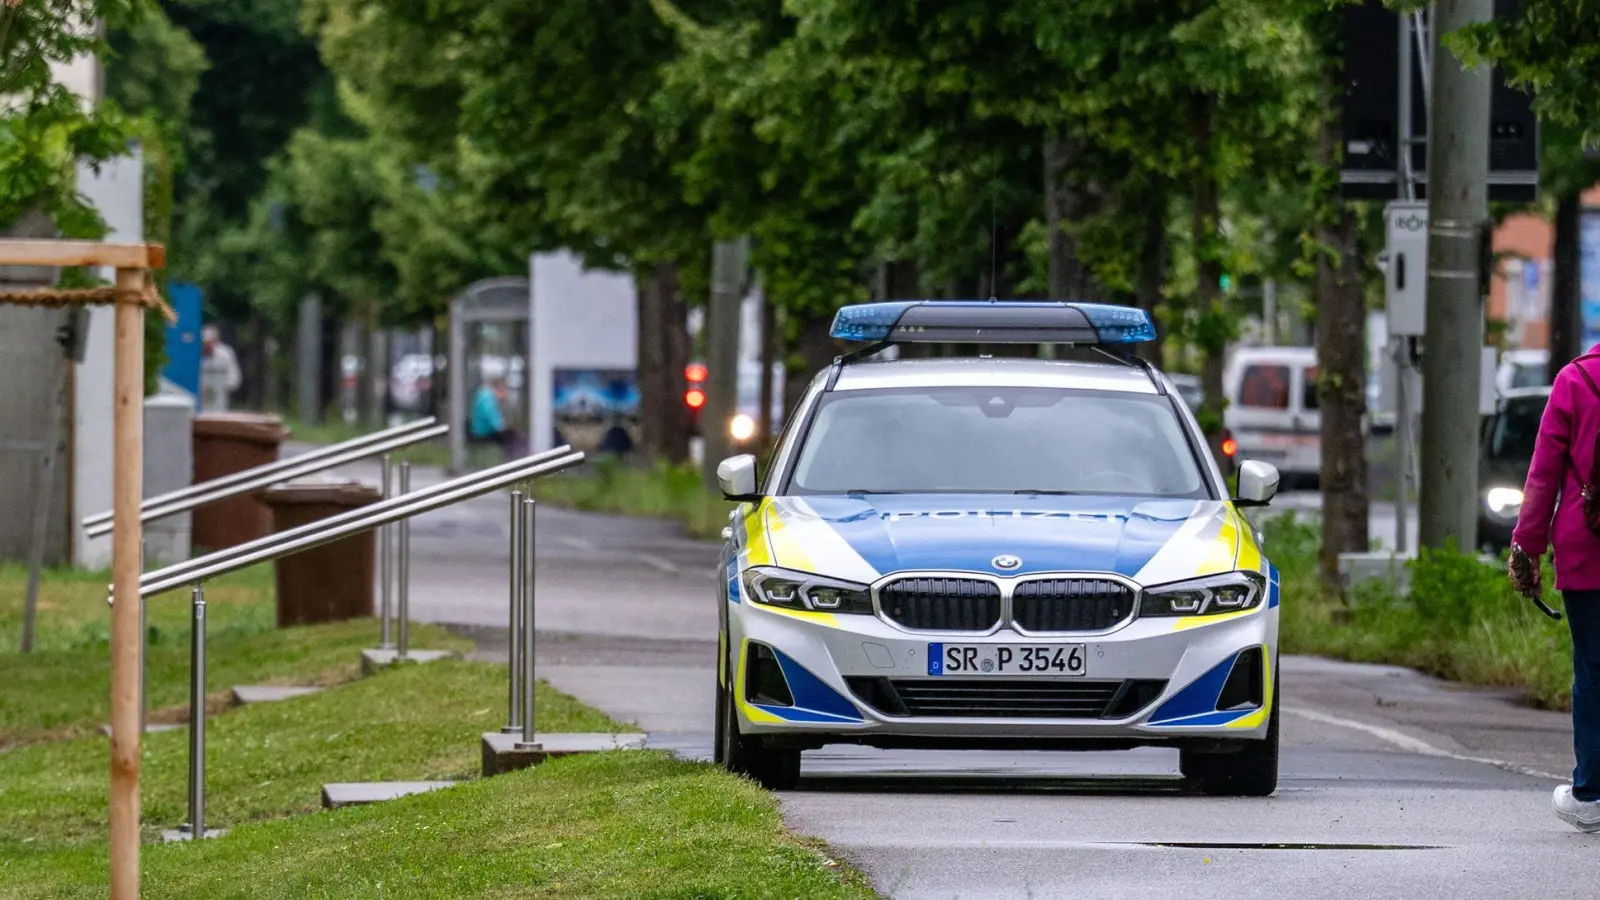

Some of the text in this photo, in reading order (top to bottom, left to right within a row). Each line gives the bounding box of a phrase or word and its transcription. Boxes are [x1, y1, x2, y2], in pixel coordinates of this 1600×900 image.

[889, 509, 1116, 522] POLIZEI
[932, 661, 939, 669] D
[946, 647, 1082, 672] SR P 3546
